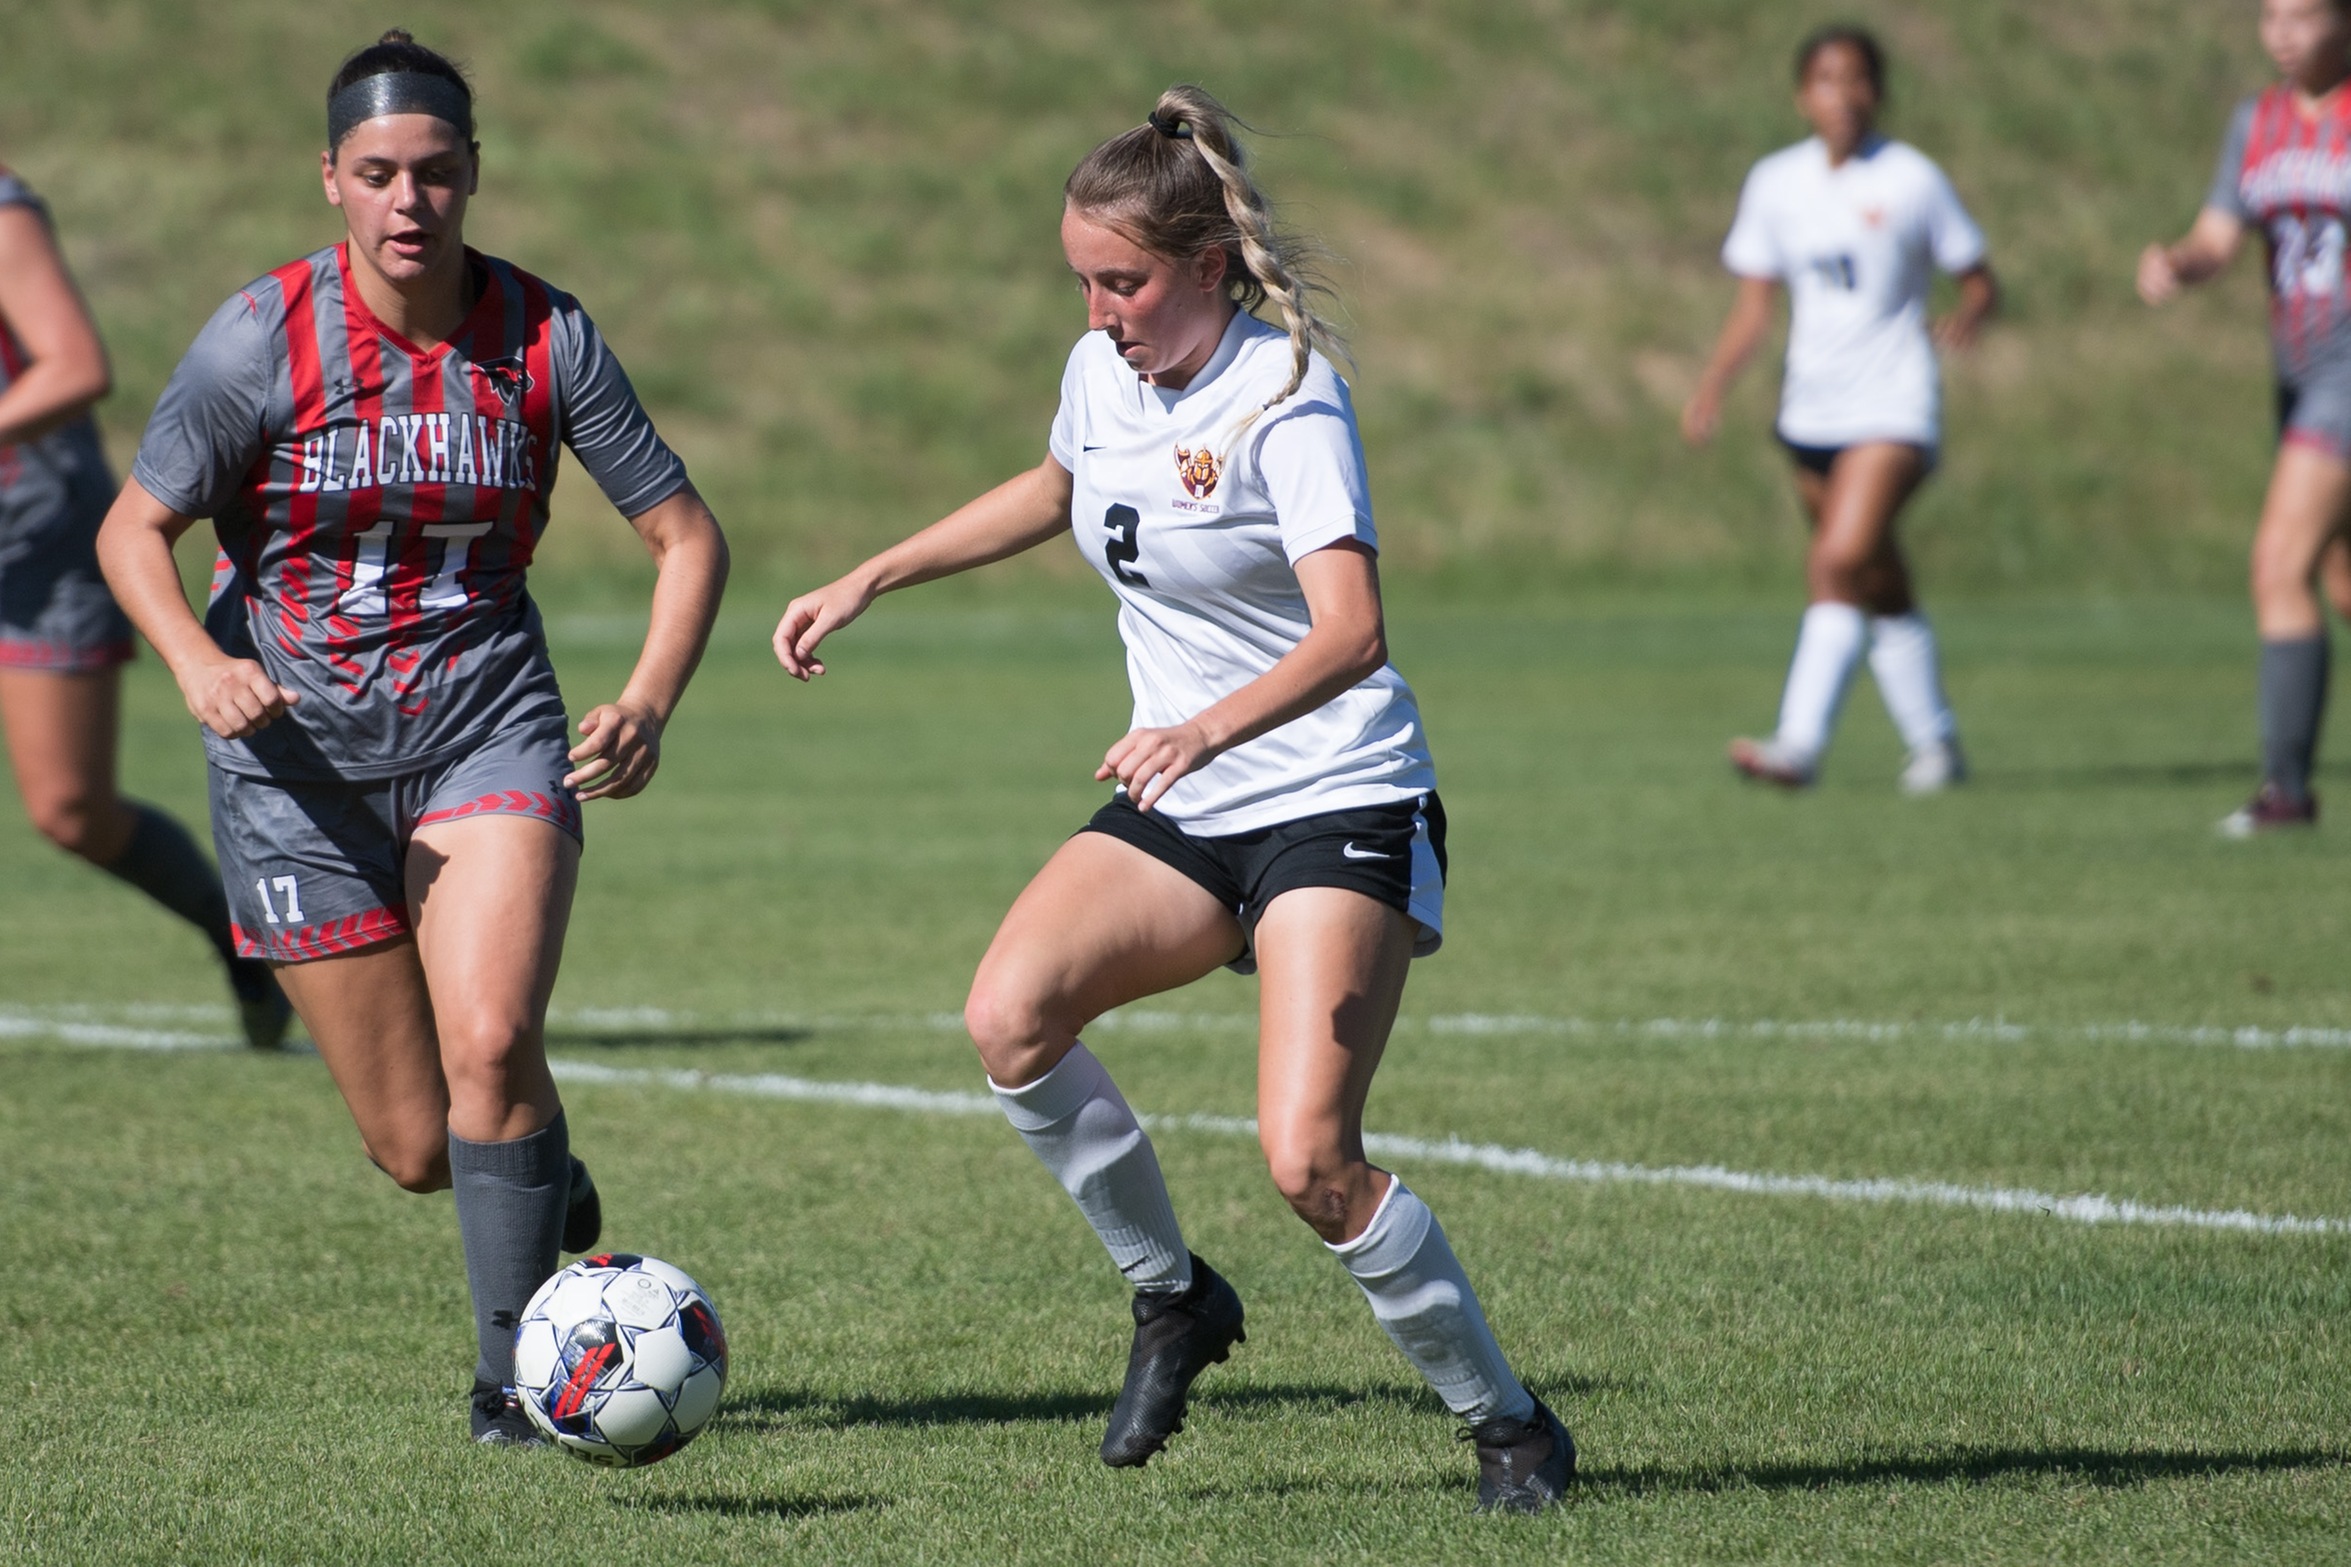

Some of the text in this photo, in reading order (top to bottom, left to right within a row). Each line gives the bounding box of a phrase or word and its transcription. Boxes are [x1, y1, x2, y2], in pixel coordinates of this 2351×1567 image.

[300, 412, 536, 491] BLACKHAWKS
[338, 520, 494, 615] 17
[1104, 502, 1152, 588] 2
[256, 874, 305, 923] 17
